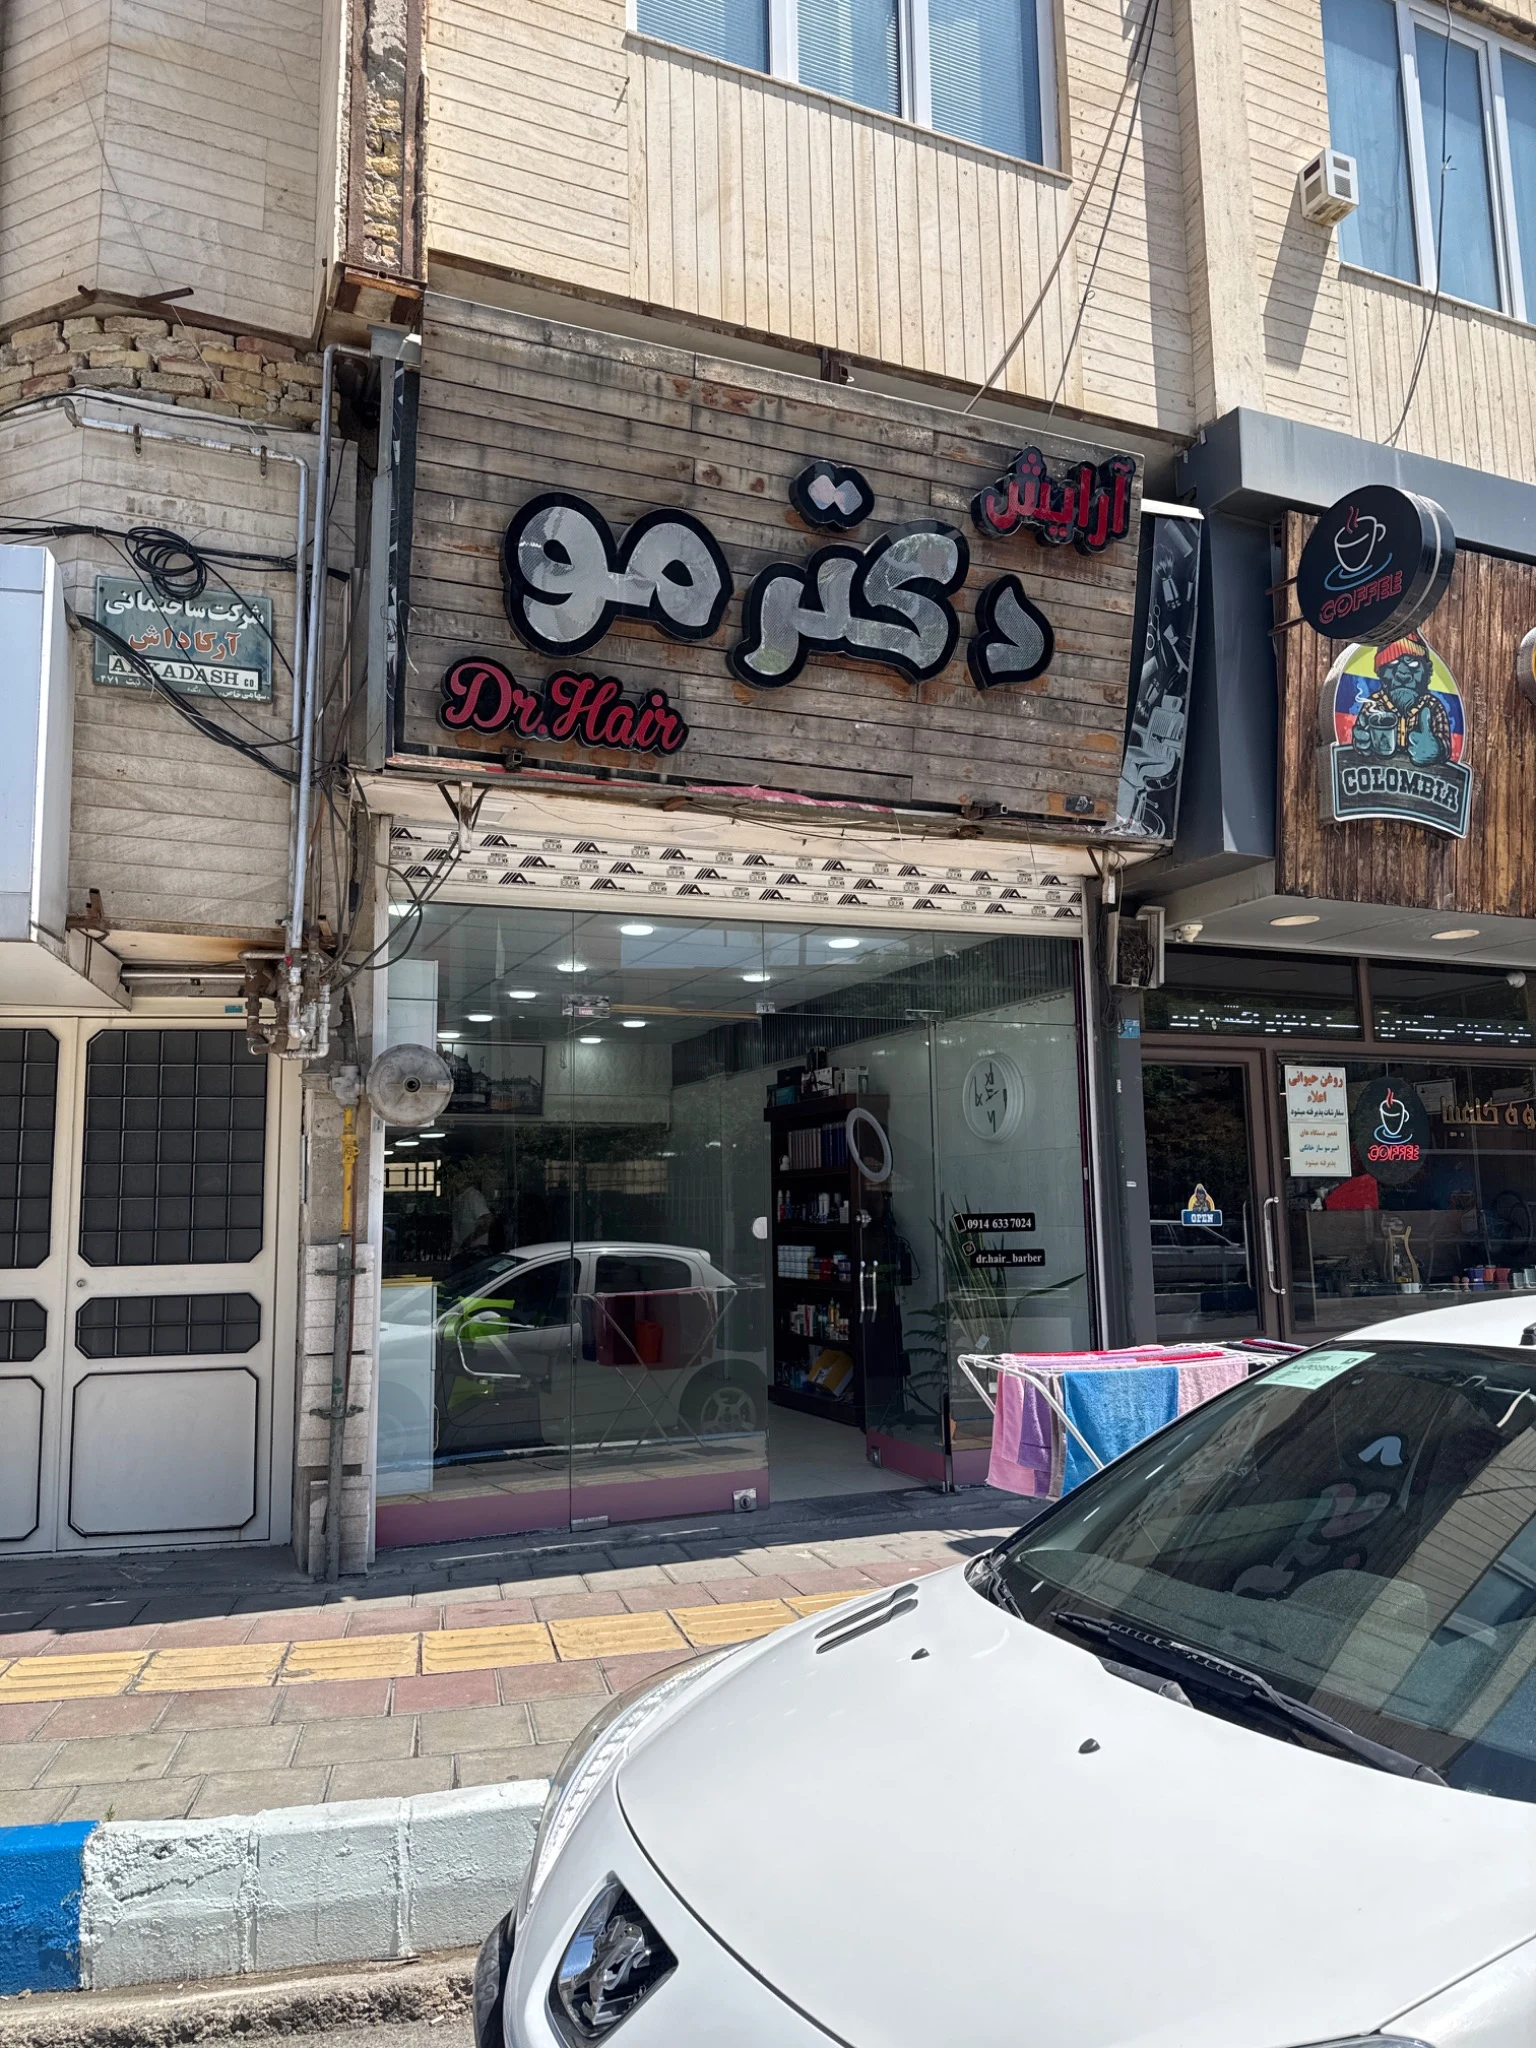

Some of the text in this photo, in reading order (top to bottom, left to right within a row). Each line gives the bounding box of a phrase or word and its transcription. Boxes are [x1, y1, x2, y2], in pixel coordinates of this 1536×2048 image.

[985, 453, 1131, 546] آرایش
[517, 473, 1044, 677] دکتر مو
[1318, 571, 1403, 624] COFFEE
[128, 625, 240, 661] آرکاداش
[110, 658, 239, 686] AADASH
[1342, 767, 1459, 812] COLOMBIA
[1367, 1144, 1420, 1161] COFFEE
[967, 1217, 1032, 1229] 0914 633 7024
[1190, 1213, 1214, 1224] OPEN
